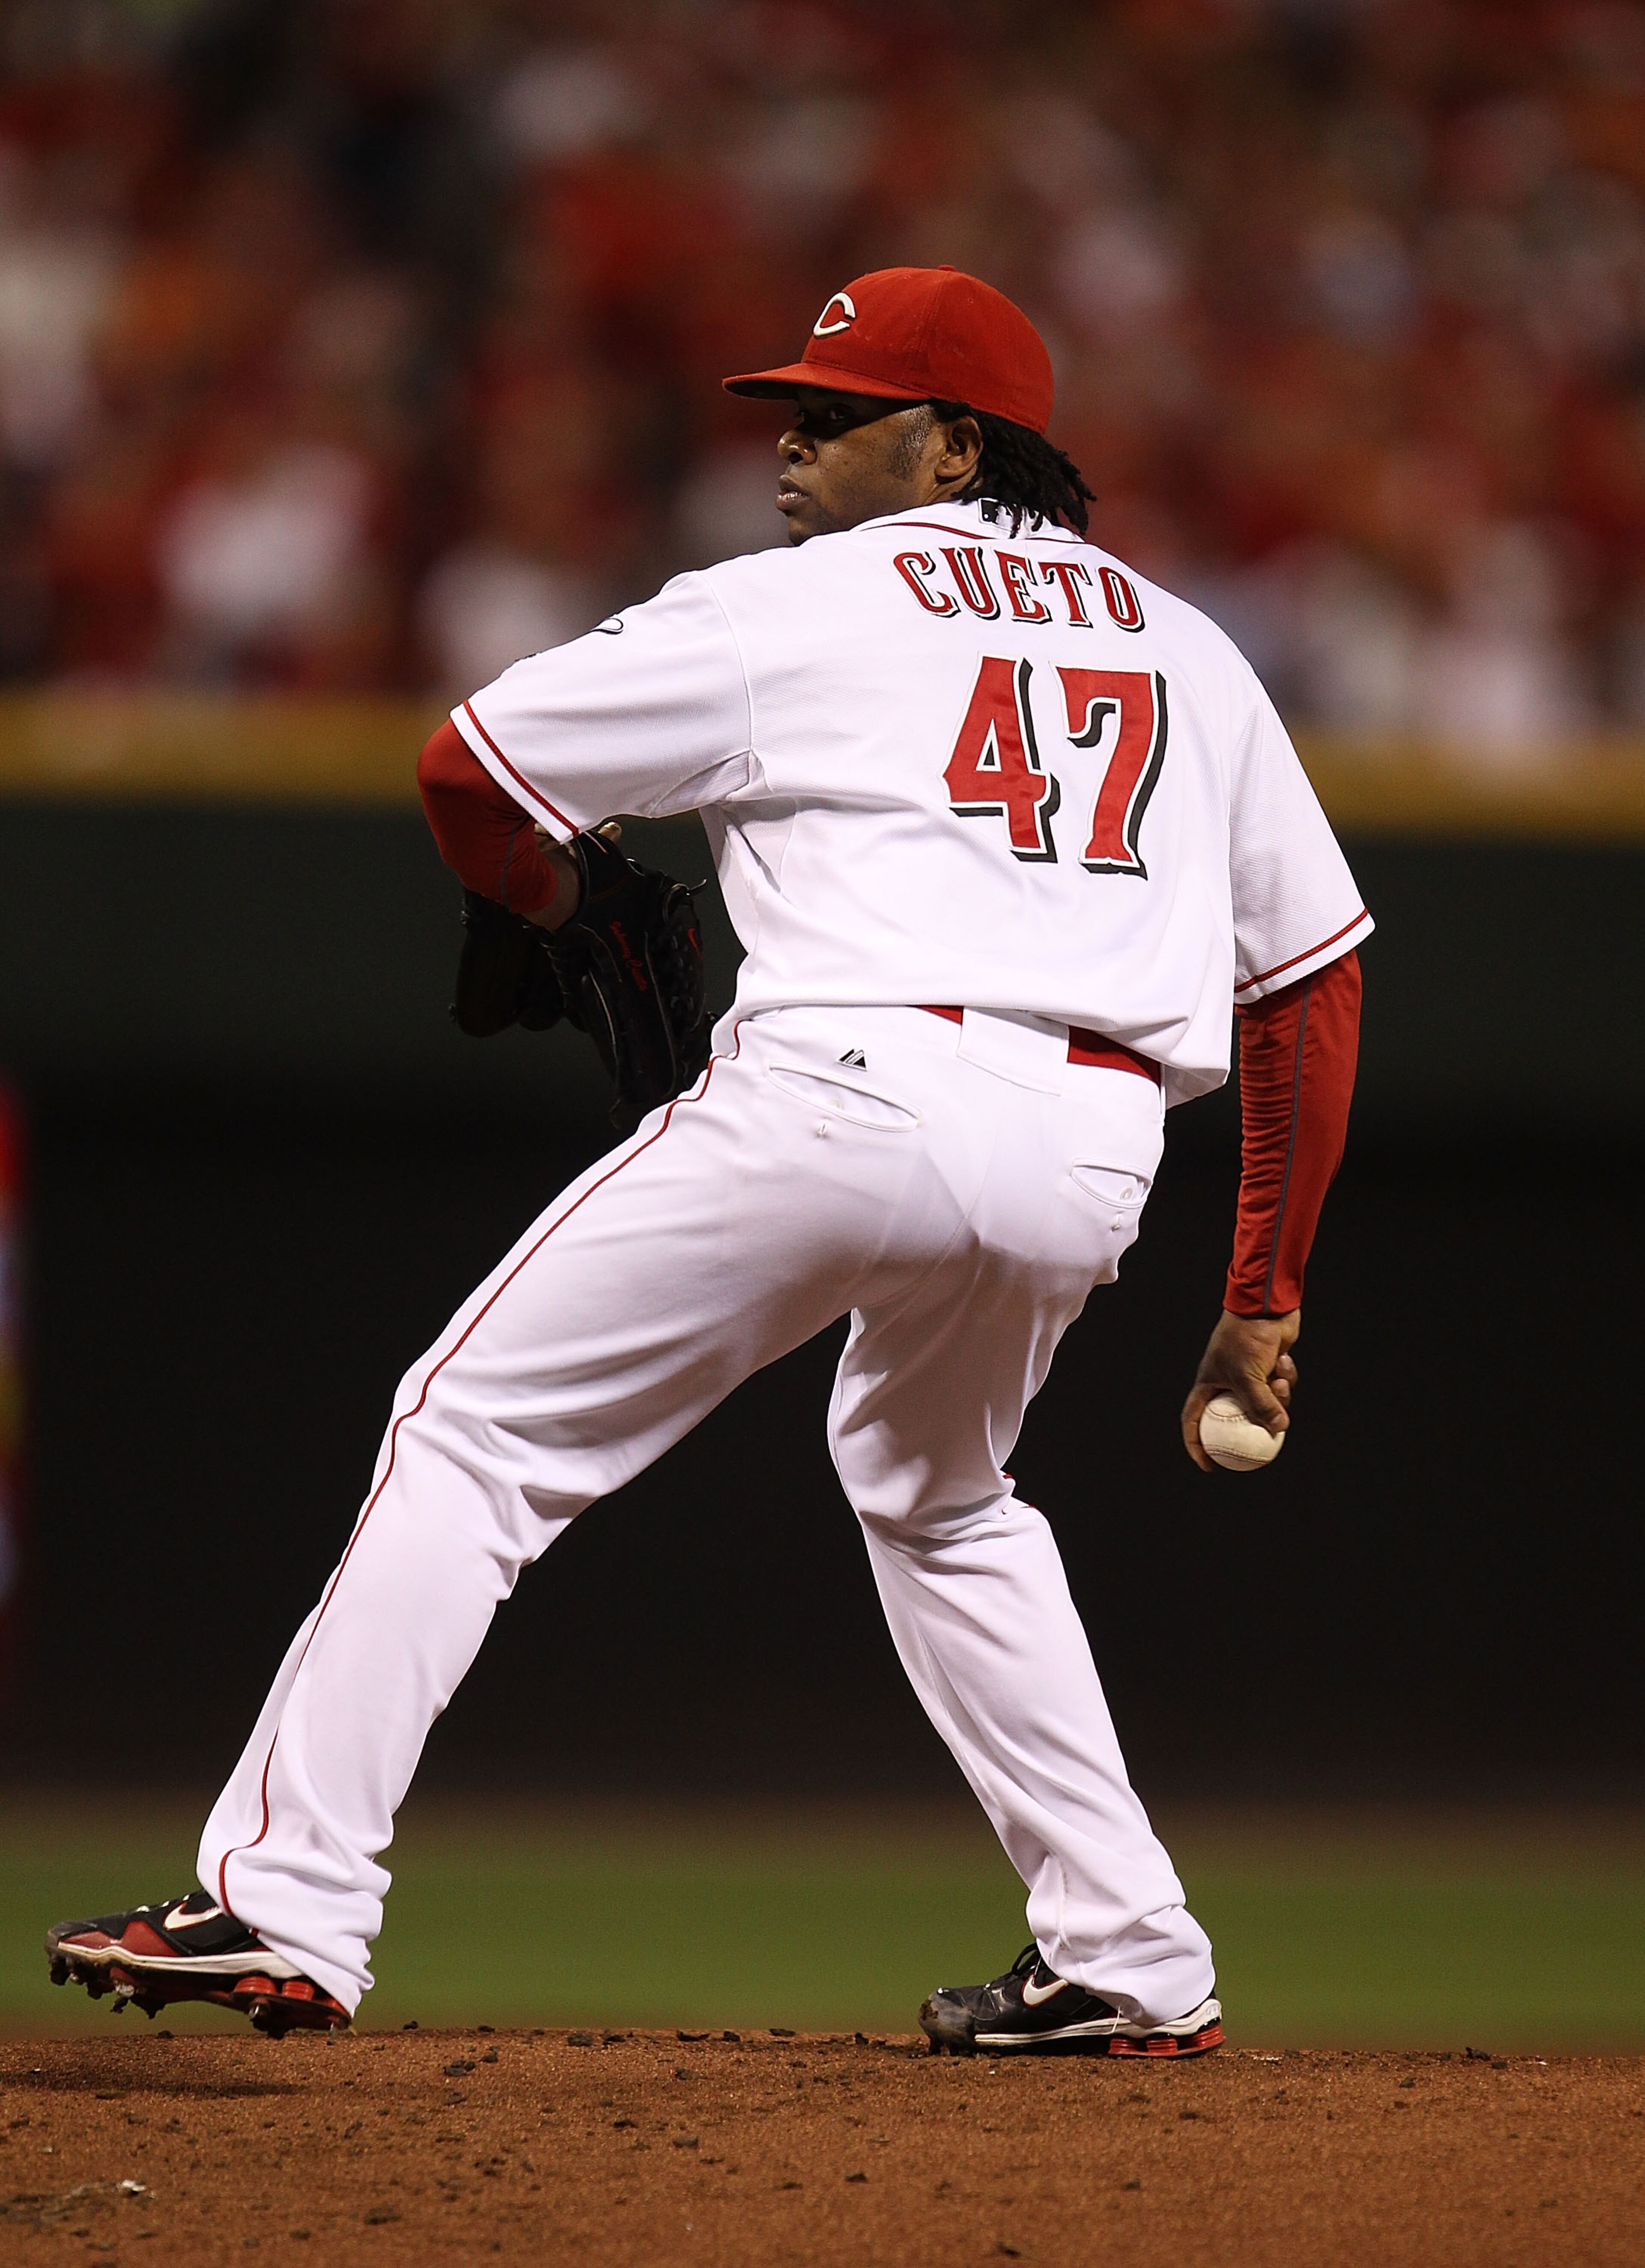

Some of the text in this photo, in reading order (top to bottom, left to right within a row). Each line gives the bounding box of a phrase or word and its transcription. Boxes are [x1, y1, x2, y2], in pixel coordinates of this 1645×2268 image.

[813, 292, 856, 339] C
[891, 546, 1145, 633] CUETO
[940, 653, 1168, 880] 47
